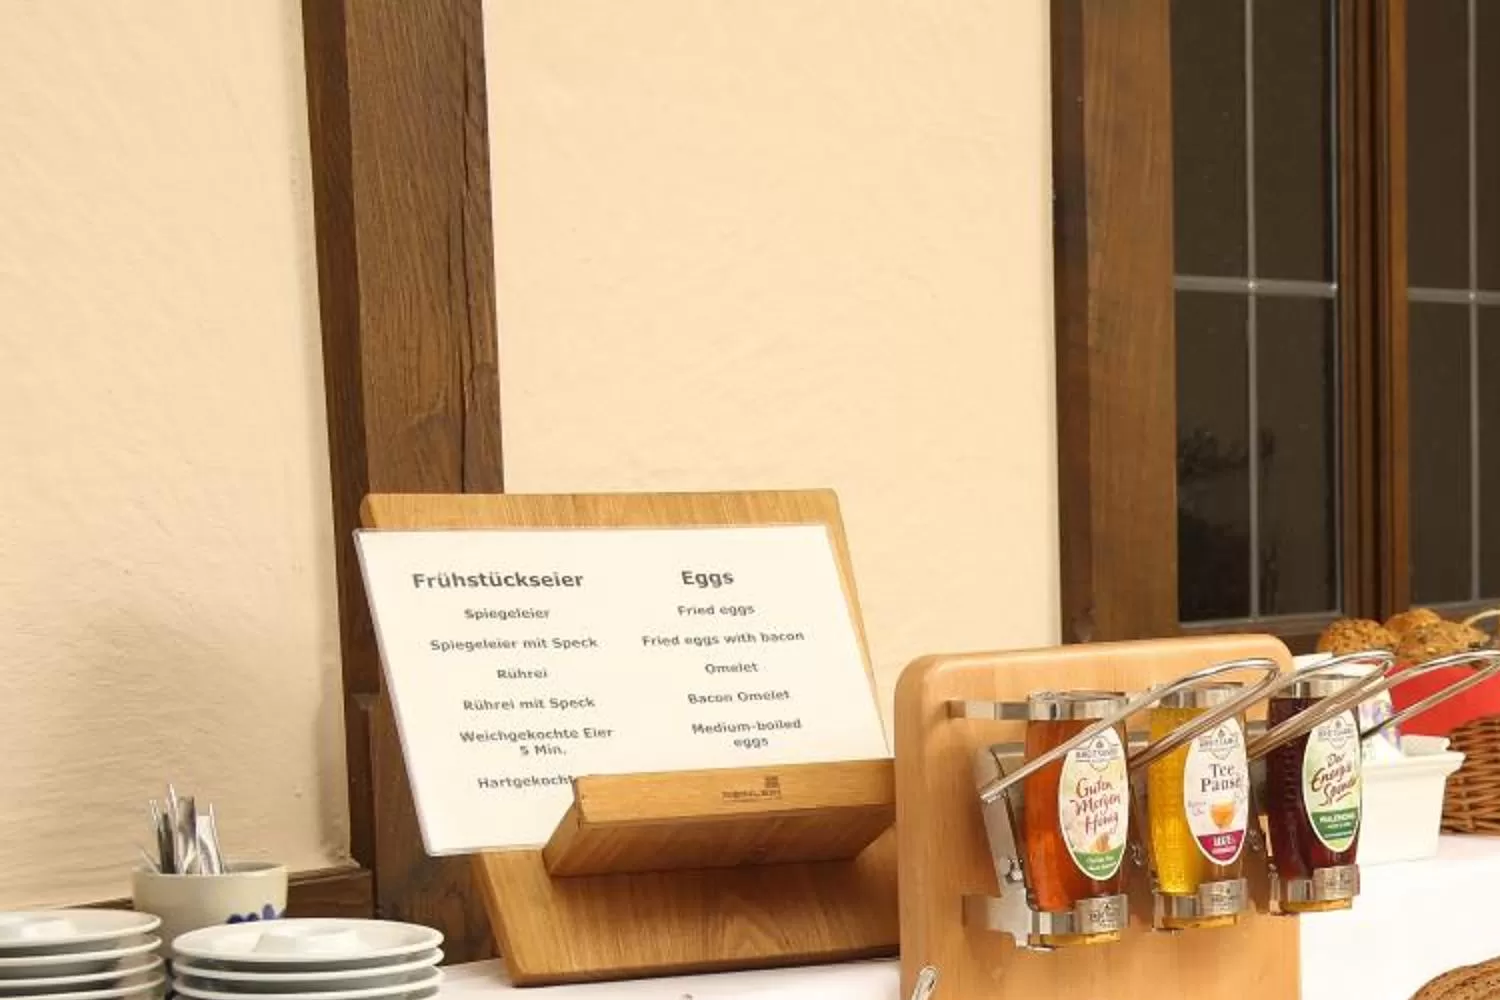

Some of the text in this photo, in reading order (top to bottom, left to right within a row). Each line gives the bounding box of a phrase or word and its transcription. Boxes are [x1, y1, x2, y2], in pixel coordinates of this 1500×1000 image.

[412, 572, 584, 588] Frühstückseier
[681, 570, 735, 588] Eggs
[464, 608, 551, 620] Spiegeleier
[677, 604, 756, 616] Fried eggs
[430, 636, 598, 652] Spiegeleier mit Speck
[641, 631, 805, 647] Fried eggs with bacon
[497, 667, 549, 680] Rührei
[705, 662, 759, 674] Omelet
[463, 697, 597, 711] Rührei mit Speck
[688, 690, 790, 704] Bacon Omelet
[692, 718, 802, 734] Medium-boiled
[459, 727, 615, 743] Weichgekochte Eier
[519, 744, 567, 756] 5 Min.
[733, 737, 769, 749] eggs
[1209, 763, 1236, 778] Tee
[1076, 774, 1114, 799] Guten
[1069, 793, 1121, 816] Morgen
[1085, 812, 1119, 835] Honig
